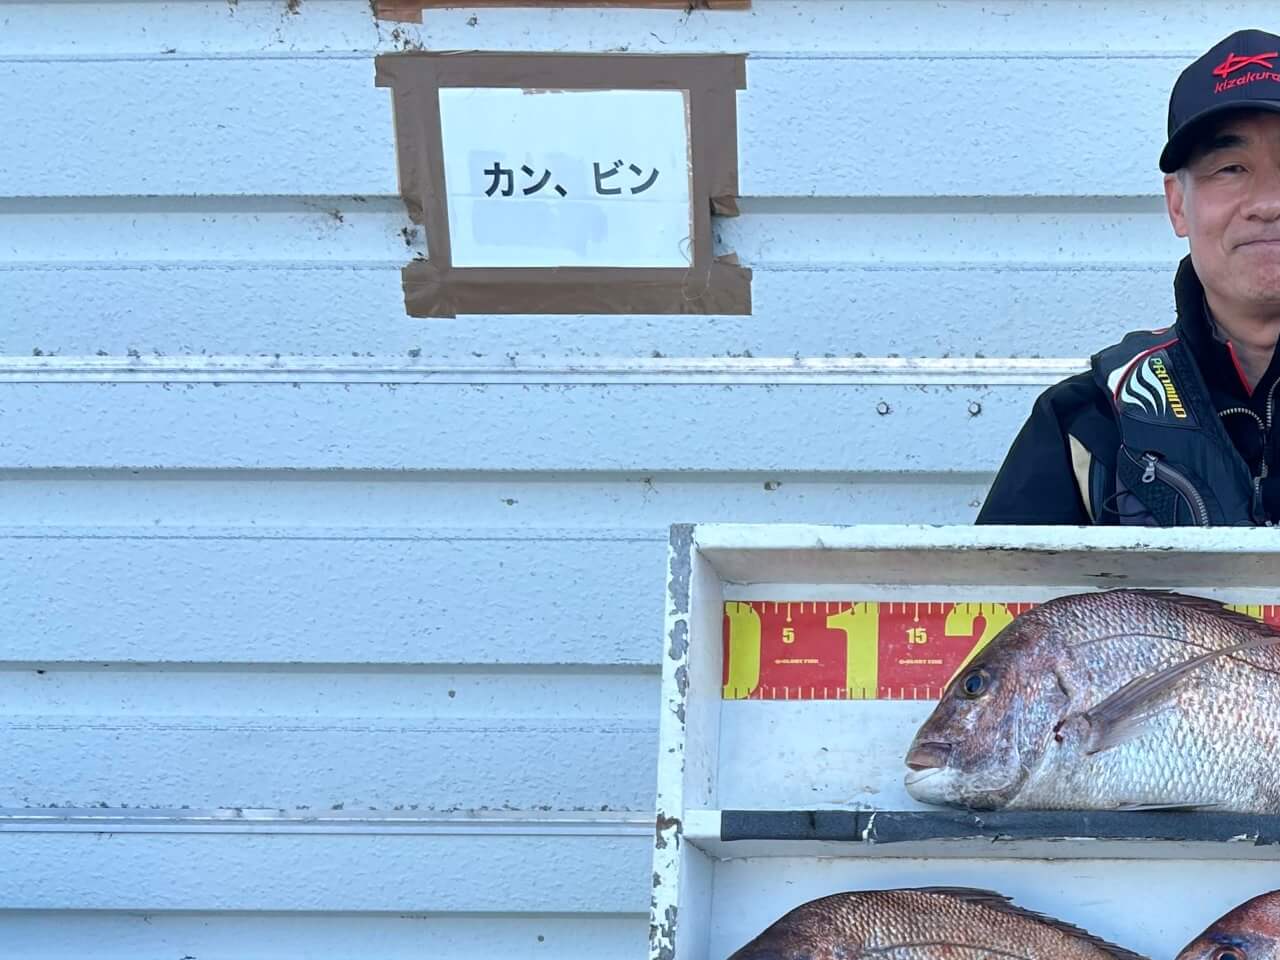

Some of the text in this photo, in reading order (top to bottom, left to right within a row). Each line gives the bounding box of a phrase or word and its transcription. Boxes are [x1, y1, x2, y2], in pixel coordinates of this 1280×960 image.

[483, 159, 660, 198] カン、ビン
[781, 628, 796, 644] 5
[905, 628, 928, 645] 15
[826, 602, 879, 699] 1
